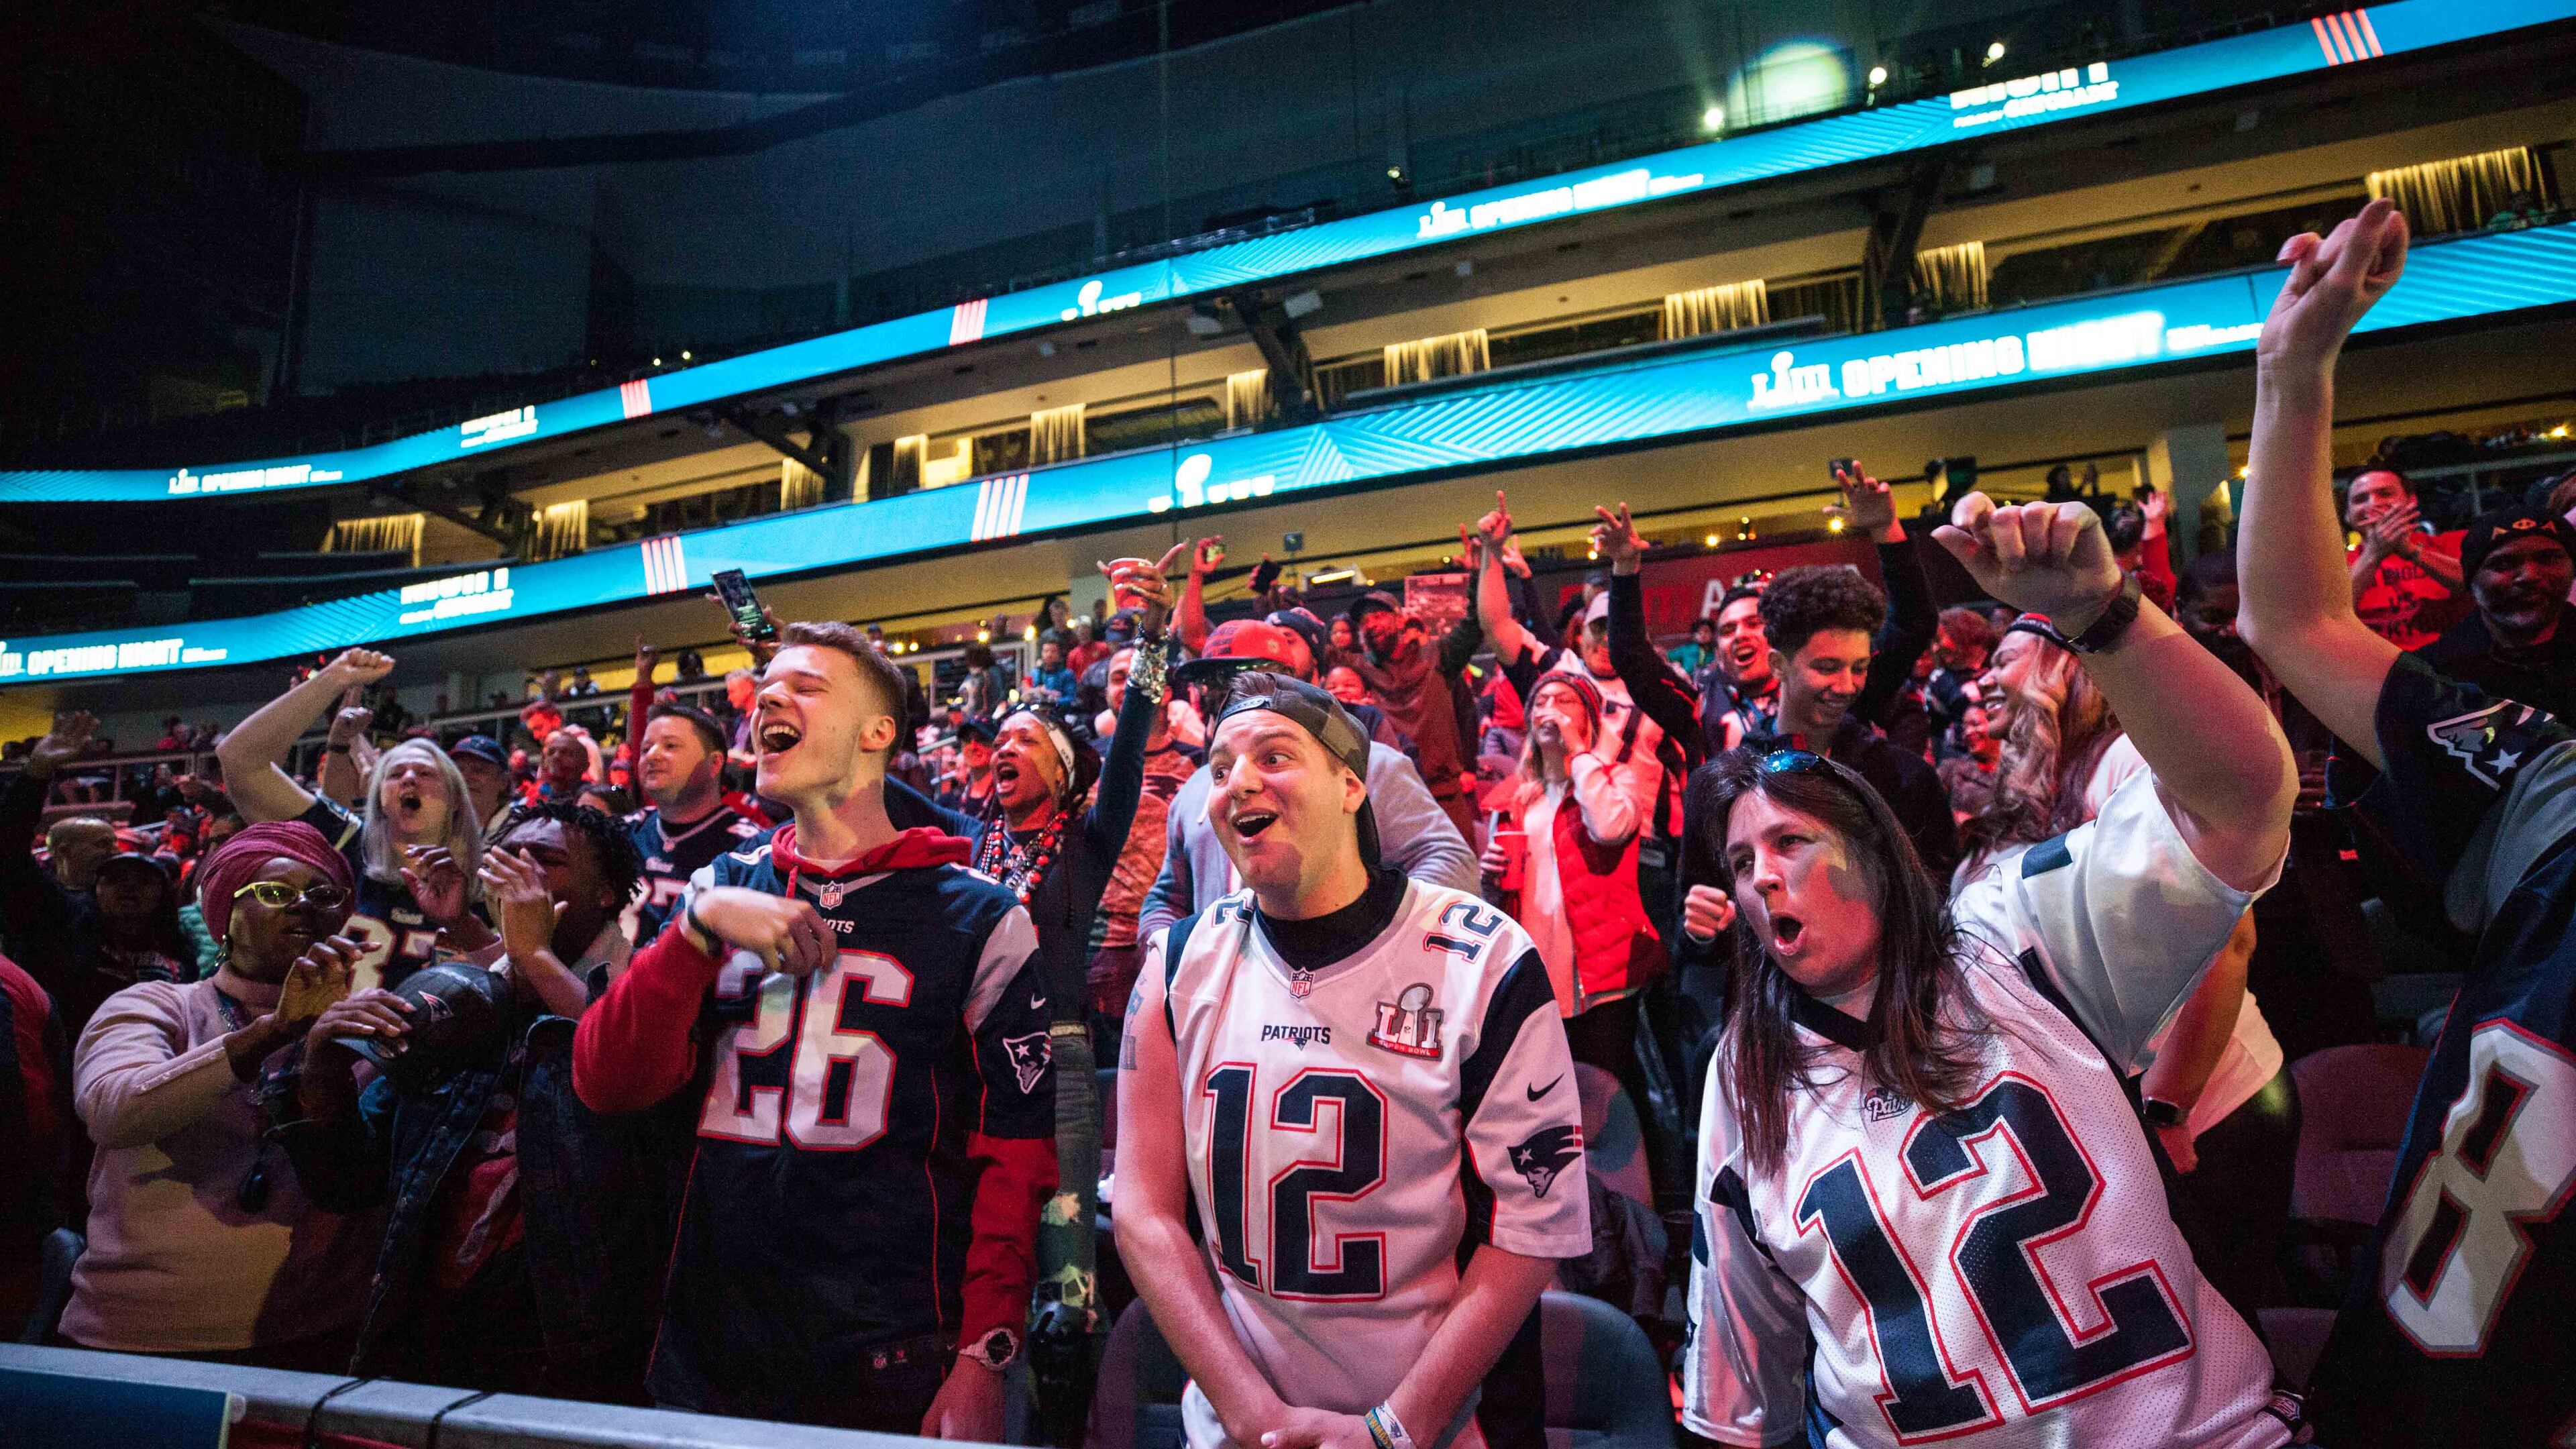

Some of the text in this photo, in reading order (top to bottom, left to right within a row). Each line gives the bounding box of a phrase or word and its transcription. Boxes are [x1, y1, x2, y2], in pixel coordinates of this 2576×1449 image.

[1842, 335, 2025, 398] OPENING
[28, 645, 117, 675] OPENING
[822, 893, 840, 904] NFL
[1423, 900, 1507, 964] 12
[1291, 981, 1310, 996] NFL
[697, 948, 914, 1151] 26
[1261, 1024, 1331, 1045] PATRIOTS
[1408, 1047, 1431, 1057] BOWL
[1204, 1062, 1388, 1303] 12
[1792, 1070, 2196, 1446] 12
